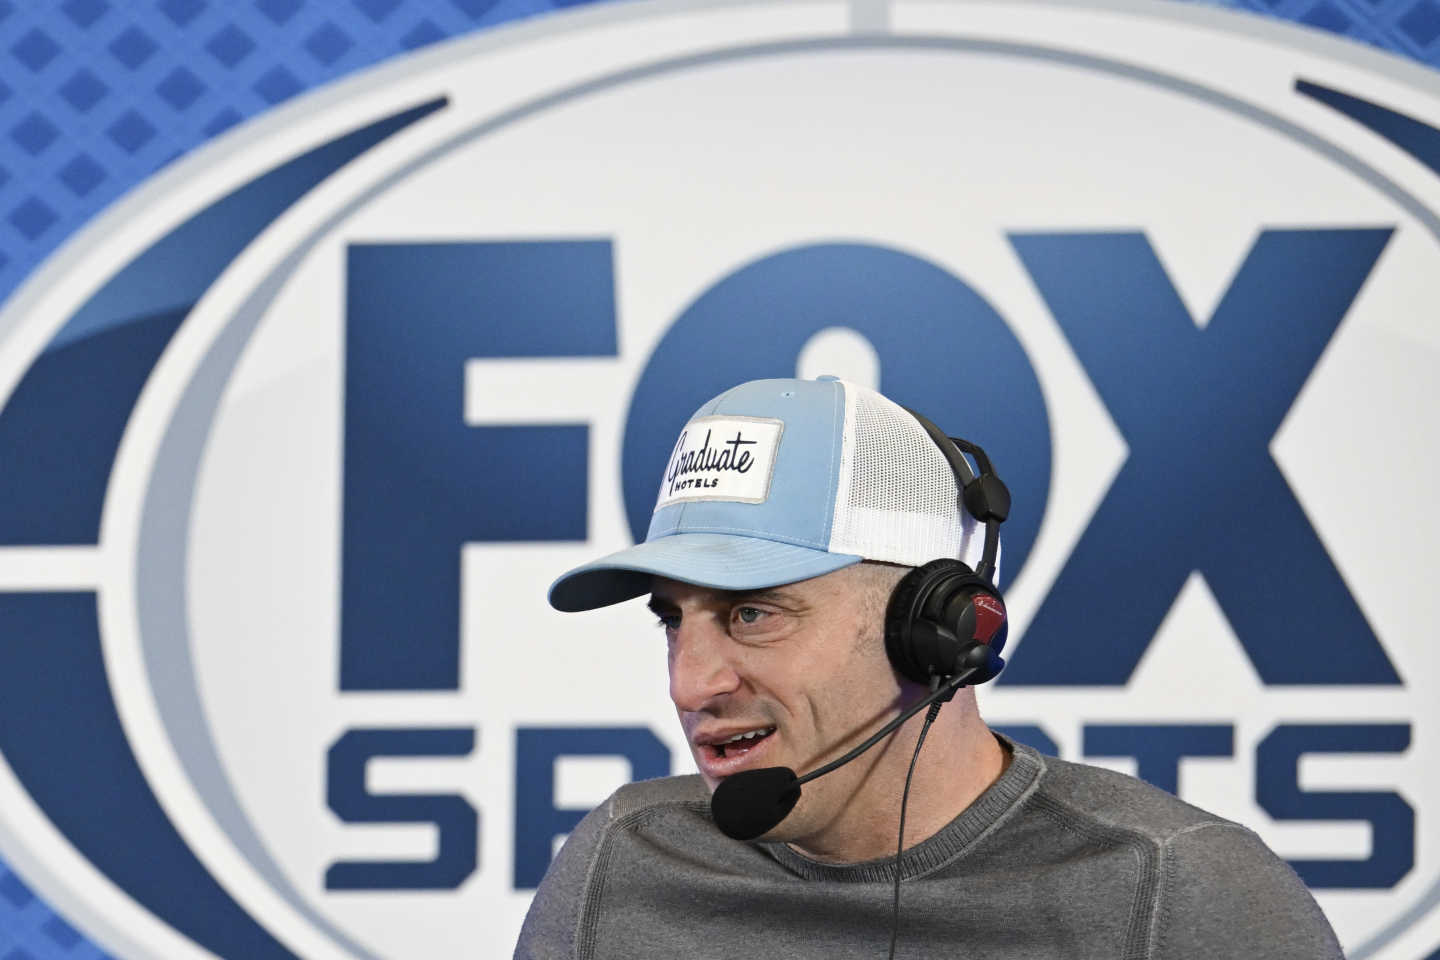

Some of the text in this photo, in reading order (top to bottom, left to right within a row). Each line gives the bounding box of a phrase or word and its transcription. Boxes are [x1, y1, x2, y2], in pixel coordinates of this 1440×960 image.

[668, 429, 757, 496] Graduate
[675, 478, 719, 492] HOTELS
[325, 722, 1416, 892] SPTS
